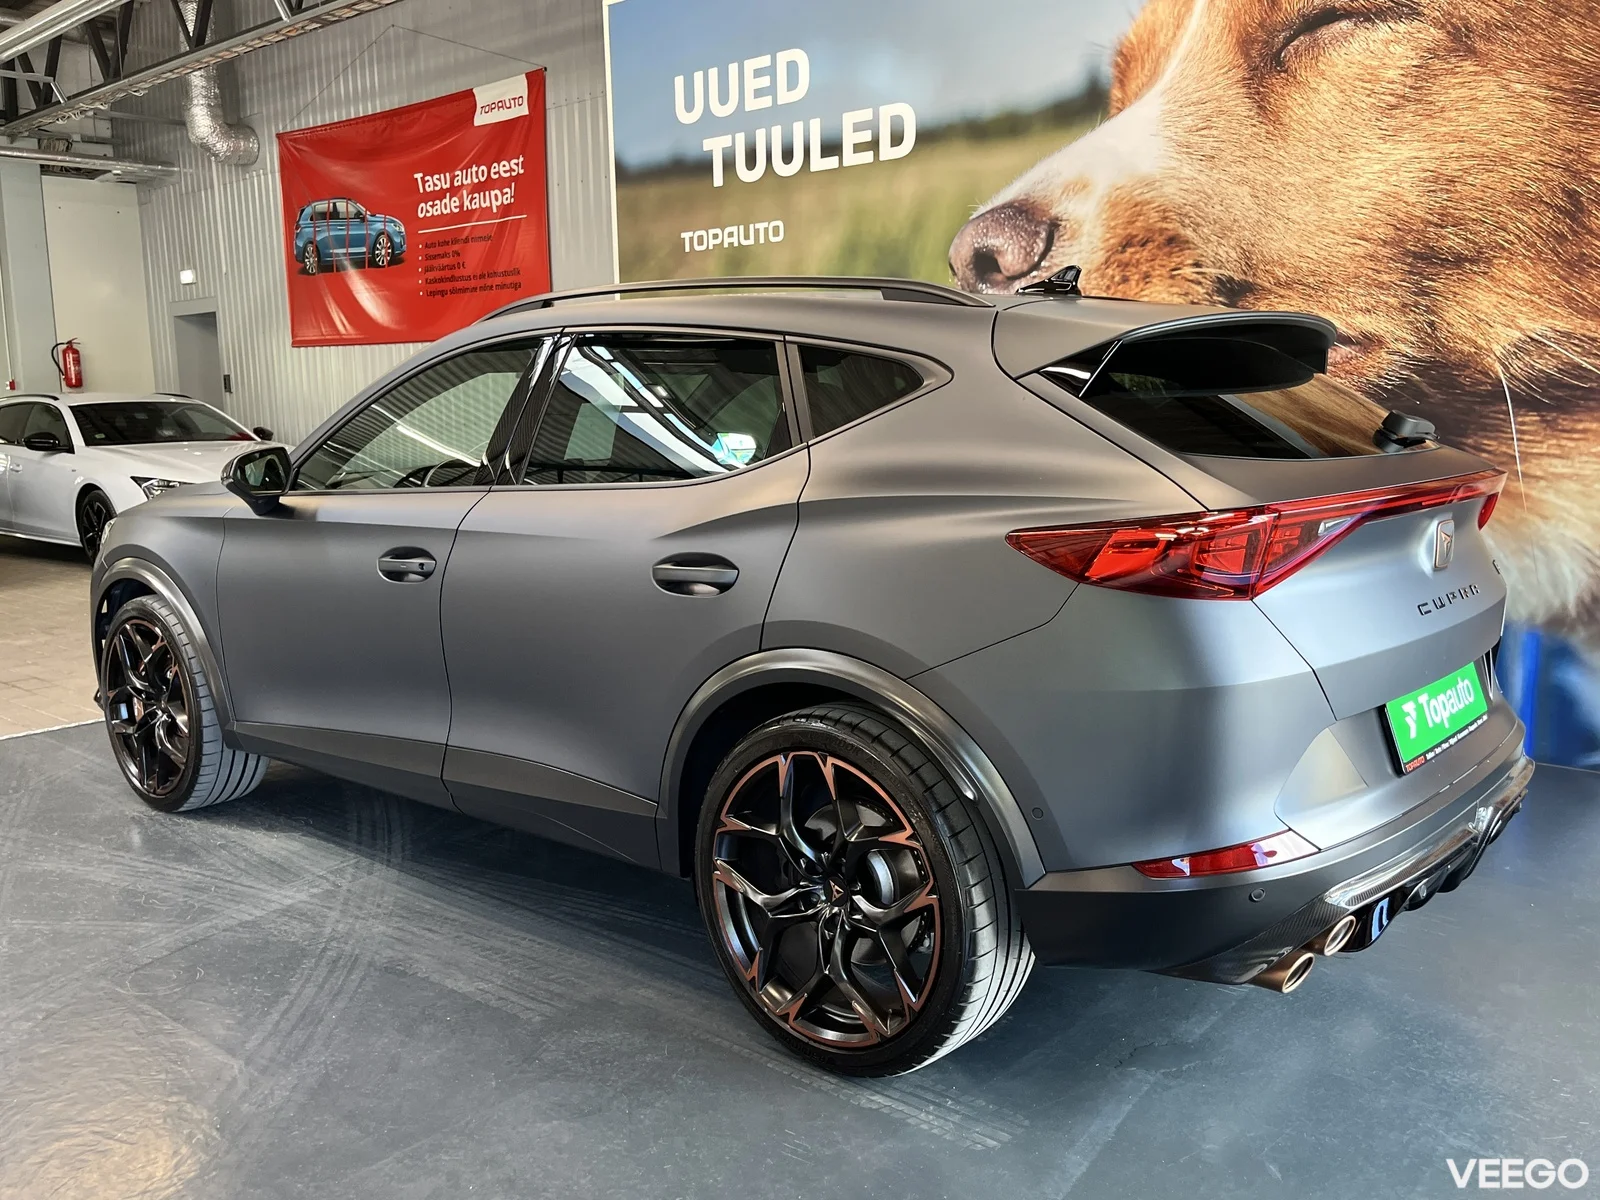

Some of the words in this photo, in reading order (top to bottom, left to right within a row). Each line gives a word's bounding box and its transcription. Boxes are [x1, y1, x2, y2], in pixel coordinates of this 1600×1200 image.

[674, 48, 810, 125] UUED
[480, 95, 524, 115] TOPAUTO
[702, 102, 917, 188] TUULED
[413, 171, 450, 194] Tasu
[453, 164, 488, 187] auto
[490, 154, 525, 179] eest
[417, 193, 460, 218] osade
[462, 182, 515, 213] kaupa!
[424, 241, 437, 249] Auto
[680, 219, 785, 253] TOPAUTO
[424, 251, 451, 261] Sissemaks
[451, 249, 461, 258] 0%
[426, 287, 448, 298] Lepingu
[495, 280, 522, 291] minutiga
[1417, 676, 1475, 729] Topauto
